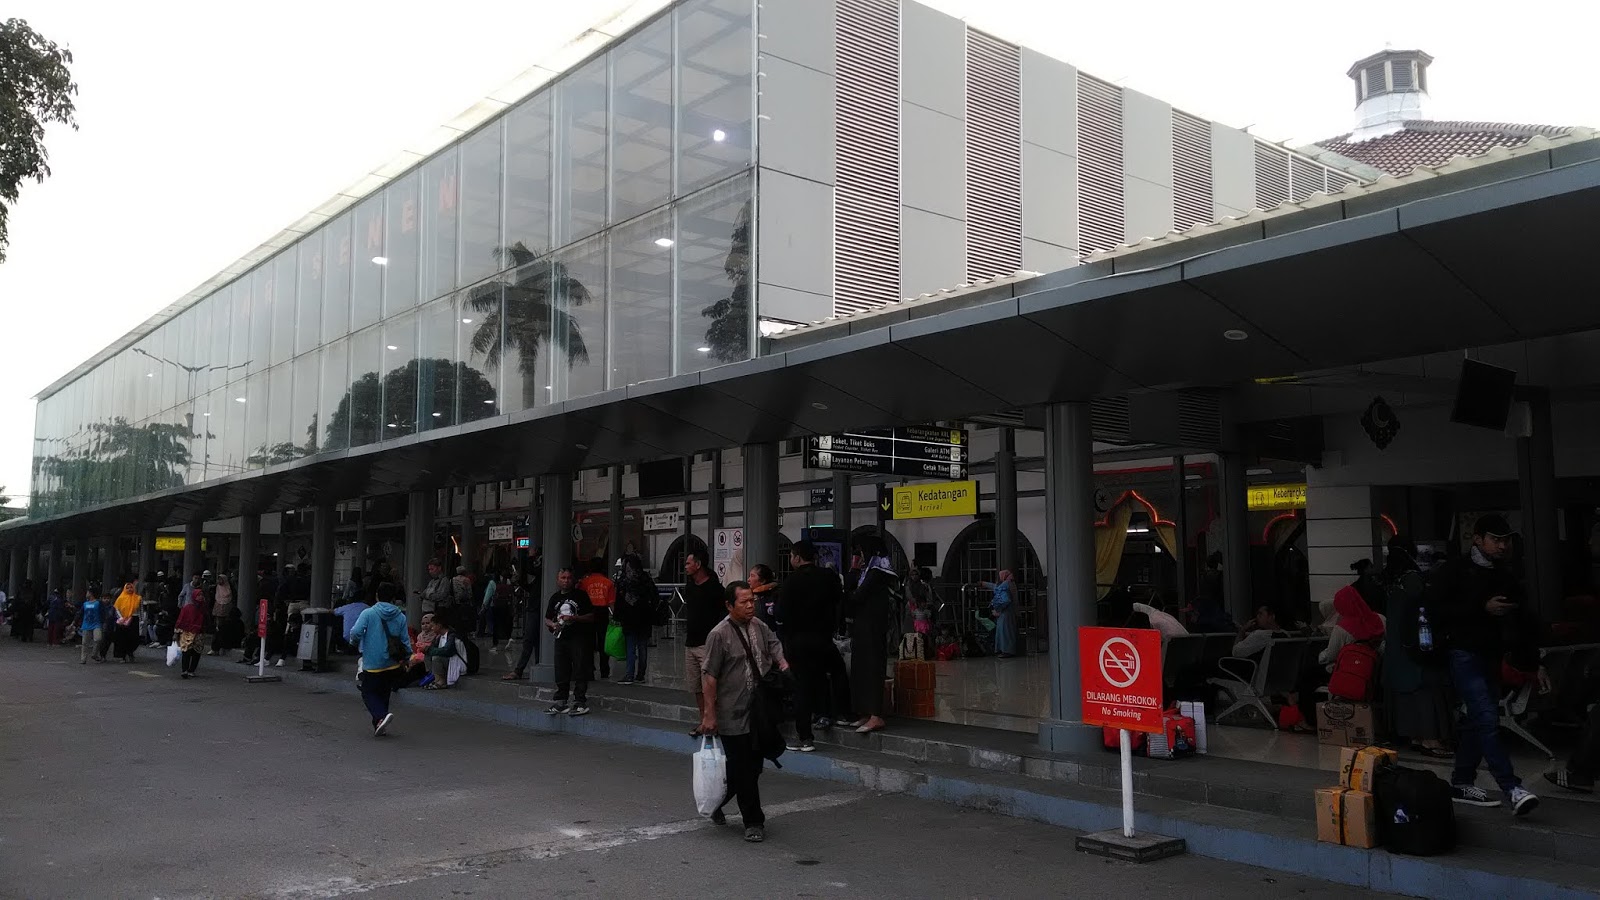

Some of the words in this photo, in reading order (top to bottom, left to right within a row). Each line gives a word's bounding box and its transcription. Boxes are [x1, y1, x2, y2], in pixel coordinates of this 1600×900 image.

[832, 456, 853, 465] Layanan
[854, 457, 879, 467] Pelanggan
[923, 463, 937, 471] Cetak
[918, 488, 968, 502] Kedatangan
[918, 502, 943, 512] Arrival
[1086, 691, 1121, 703] DILARANG
[1122, 694, 1157, 706] MEROKOK
[1102, 706, 1111, 716] No
[1112, 707, 1142, 721] Smoking
